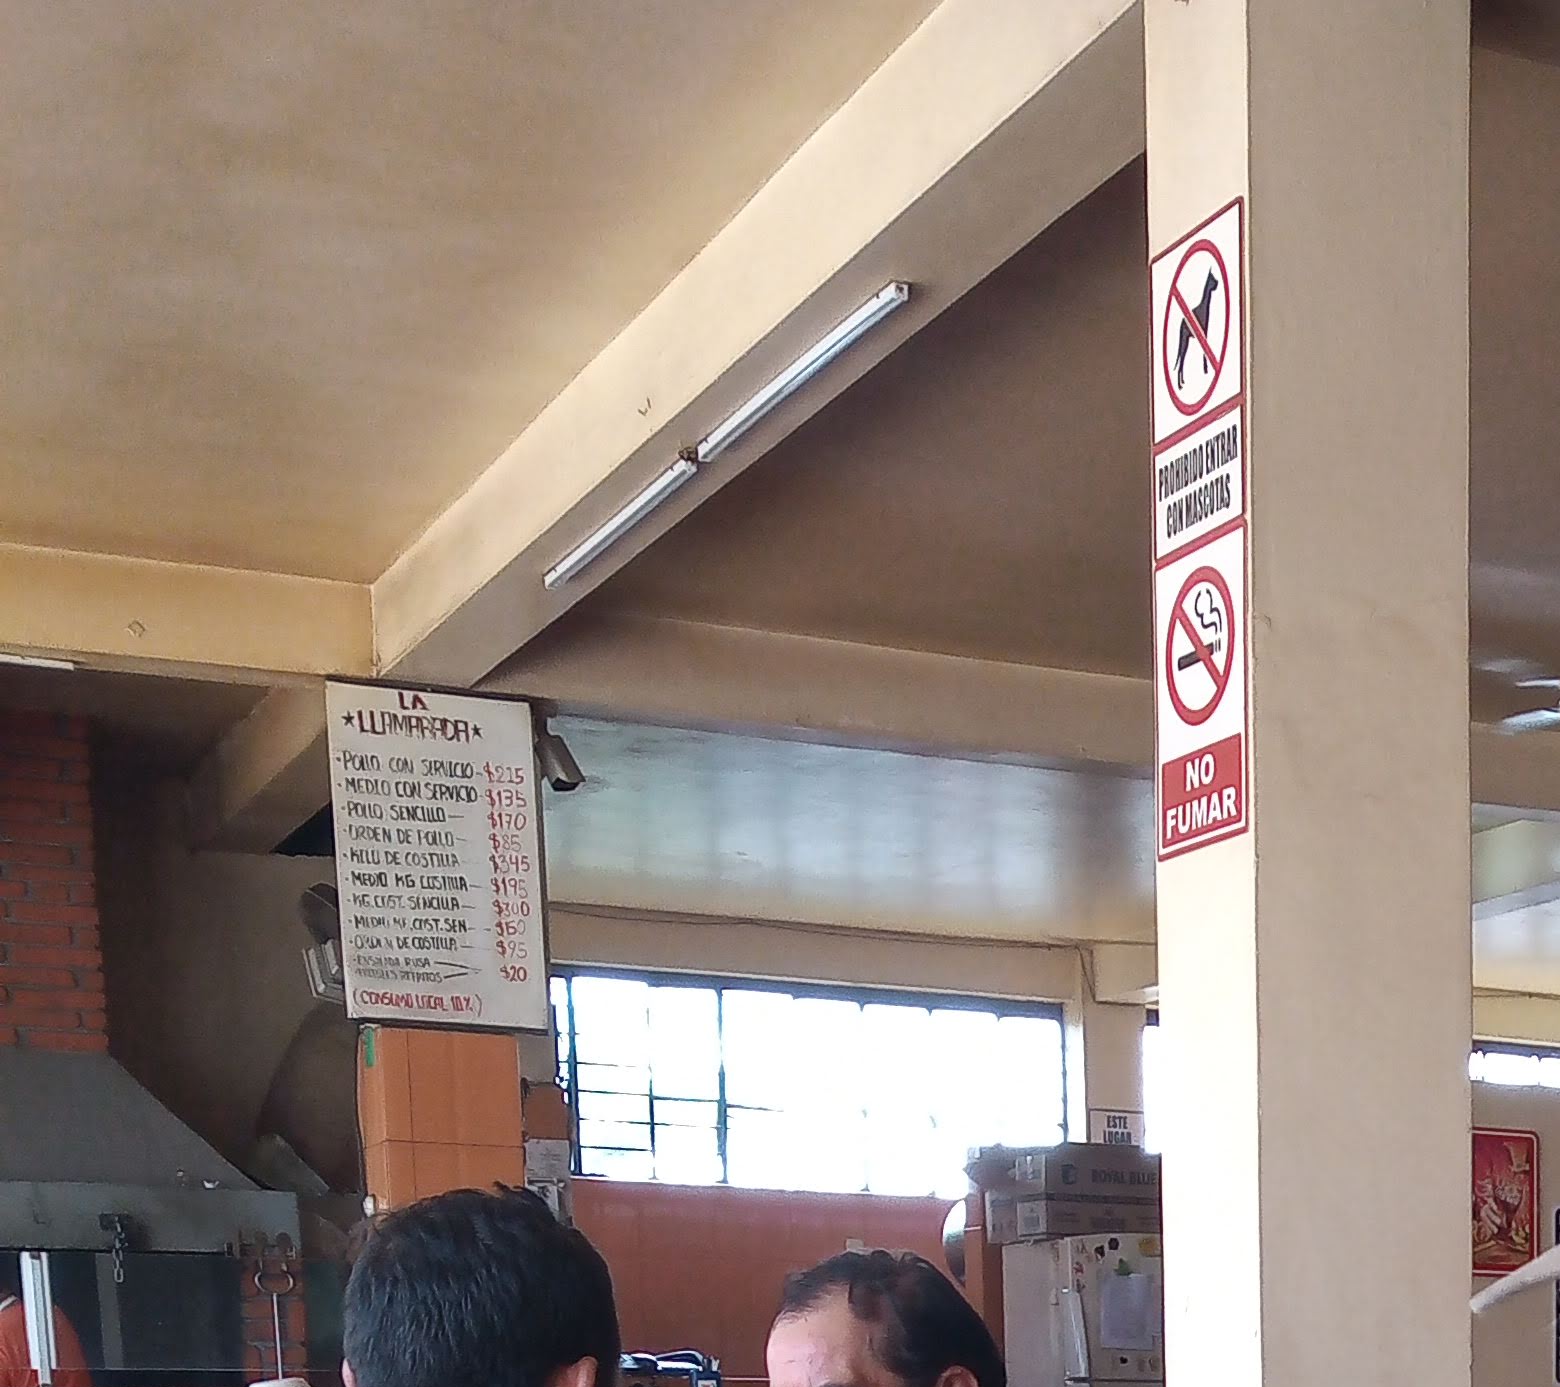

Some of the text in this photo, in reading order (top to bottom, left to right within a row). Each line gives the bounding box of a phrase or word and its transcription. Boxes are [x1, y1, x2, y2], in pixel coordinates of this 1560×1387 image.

[1159, 424, 1238, 502] PROHIBIDO ENTRAR
[1167, 473, 1231, 539] CON MASCOTAS
[398, 691, 430, 711] LA
[356, 709, 470, 744] LLAMARADA
[343, 750, 380, 772] POLLO
[388, 757, 414, 775] CON
[421, 758, 474, 779] SERVICIO
[1185, 753, 1215, 792] NO
[345, 777, 527, 809] MEDIO CON SERVICIO $135
[347, 800, 527, 831] POLLO SENCILLO $170
[1166, 786, 1238, 840] FUMAR
[348, 824, 392, 844] ORDEN
[396, 828, 412, 845] DE
[488, 832, 522, 854] $85
[385, 851, 401, 866] DE
[405, 852, 460, 868] COSTILLA
[489, 855, 531, 874] $345
[351, 871, 389, 888] MEDIO
[395, 873, 416, 888] KG
[490, 877, 529, 899] $195
[396, 936, 411, 950] DE
[500, 965, 528, 982] $20
[1106, 1114, 1128, 1129] ESTE
[1103, 1129, 1132, 1145] LUGAR
